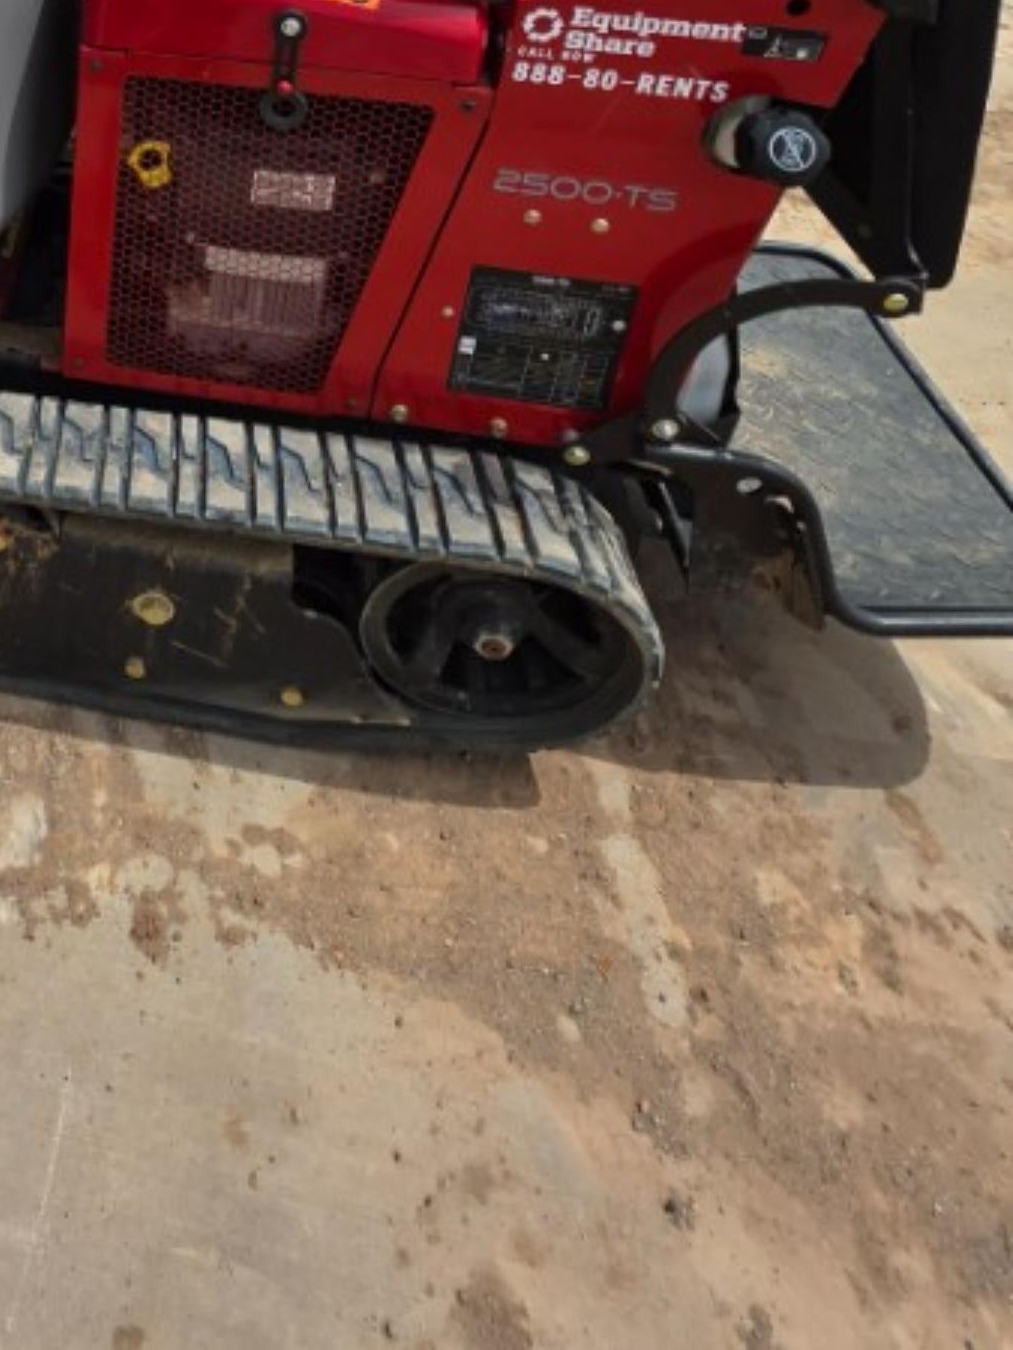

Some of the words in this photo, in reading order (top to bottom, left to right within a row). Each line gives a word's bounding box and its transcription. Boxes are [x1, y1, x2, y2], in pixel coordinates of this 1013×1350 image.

[569, 5, 746, 43] Equipment
[517, 46, 555, 60] CALL
[564, 29, 657, 59] Share
[511, 61, 731, 103] 888-80-RENTS
